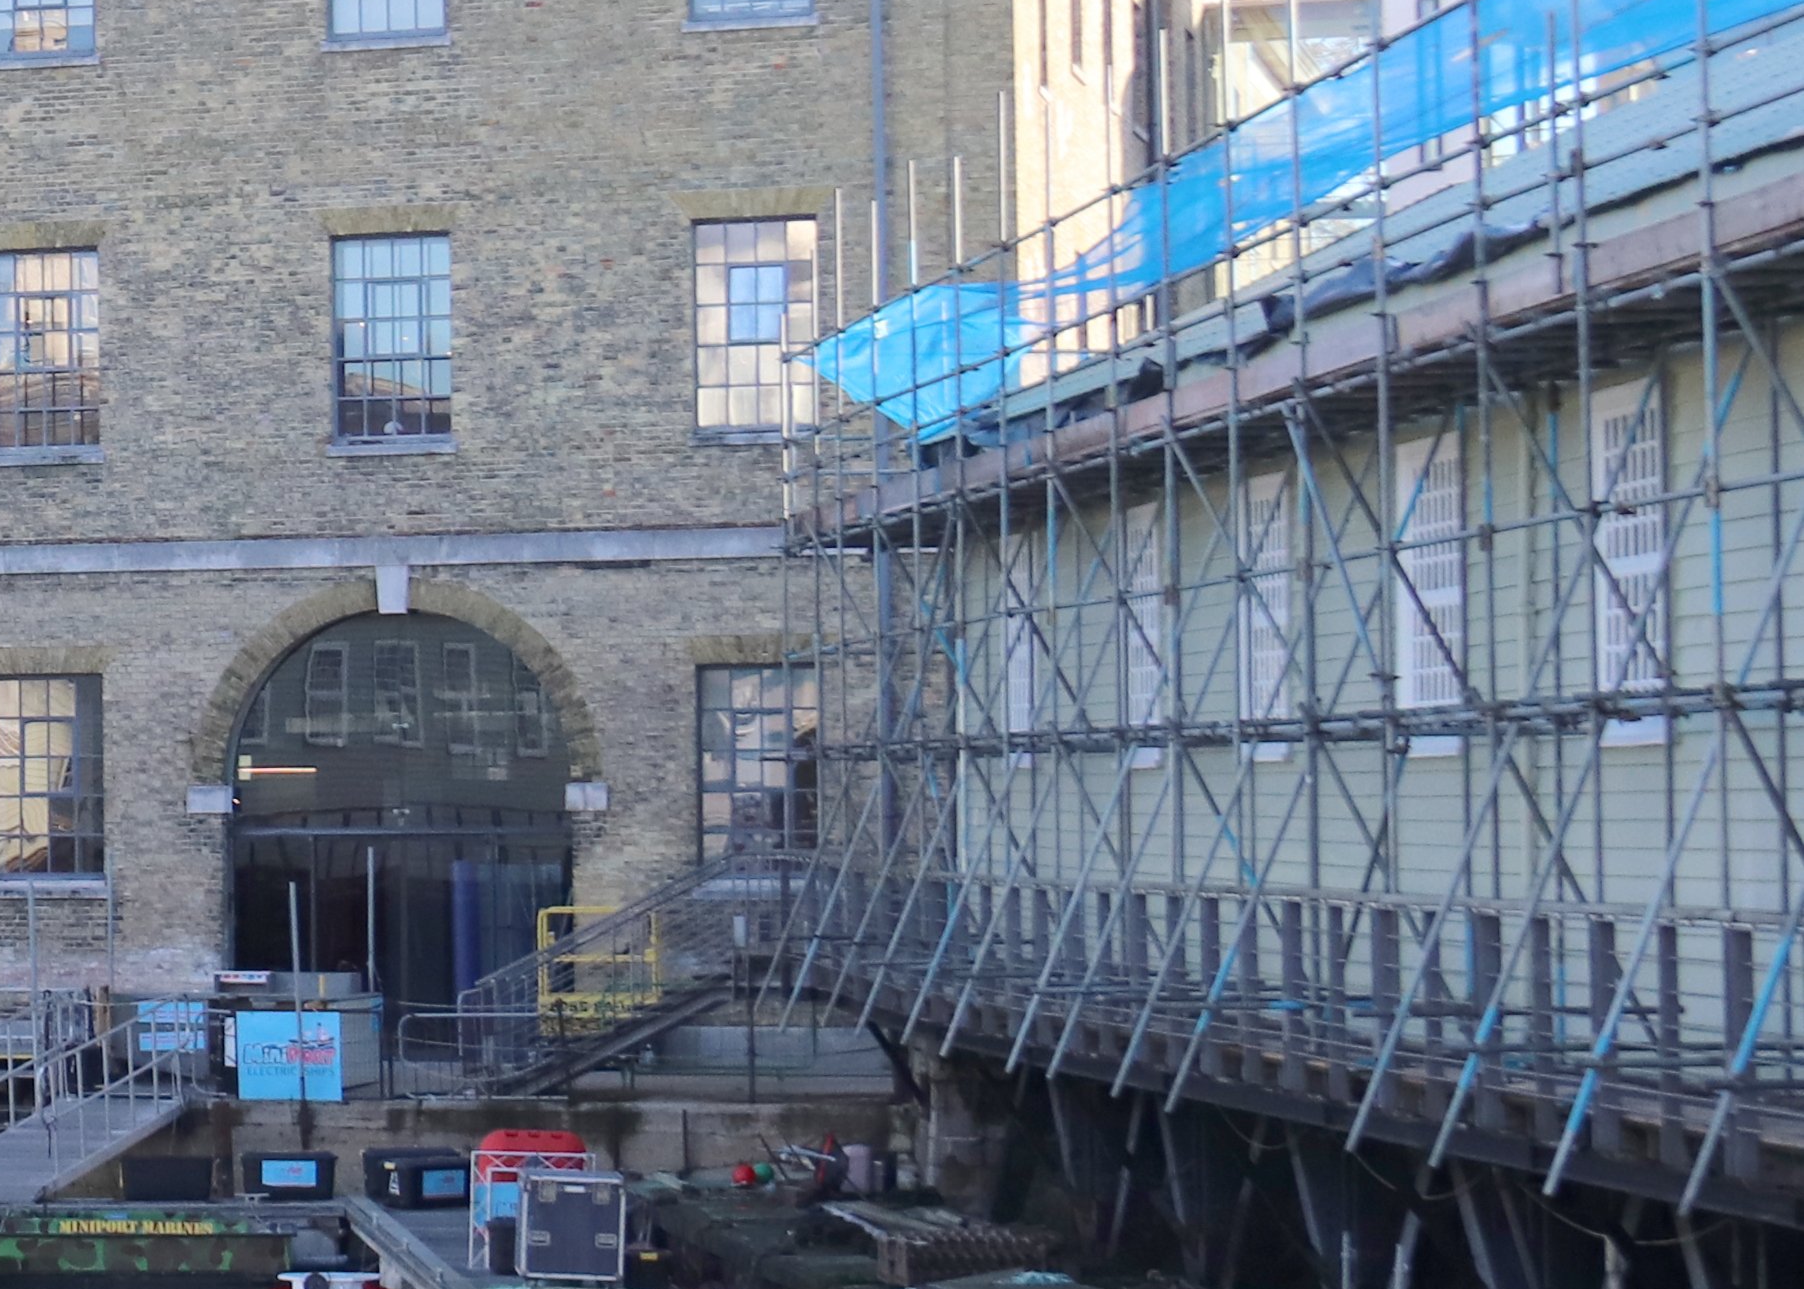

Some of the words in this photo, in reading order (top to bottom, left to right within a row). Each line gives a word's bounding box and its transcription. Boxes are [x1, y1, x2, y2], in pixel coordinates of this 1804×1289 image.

[247, 1066, 297, 1076] ELECTRIC
[305, 1067, 335, 1077] SHIPS
[59, 1220, 138, 1234] MINIPORT
[141, 1220, 214, 1235] MARINES
